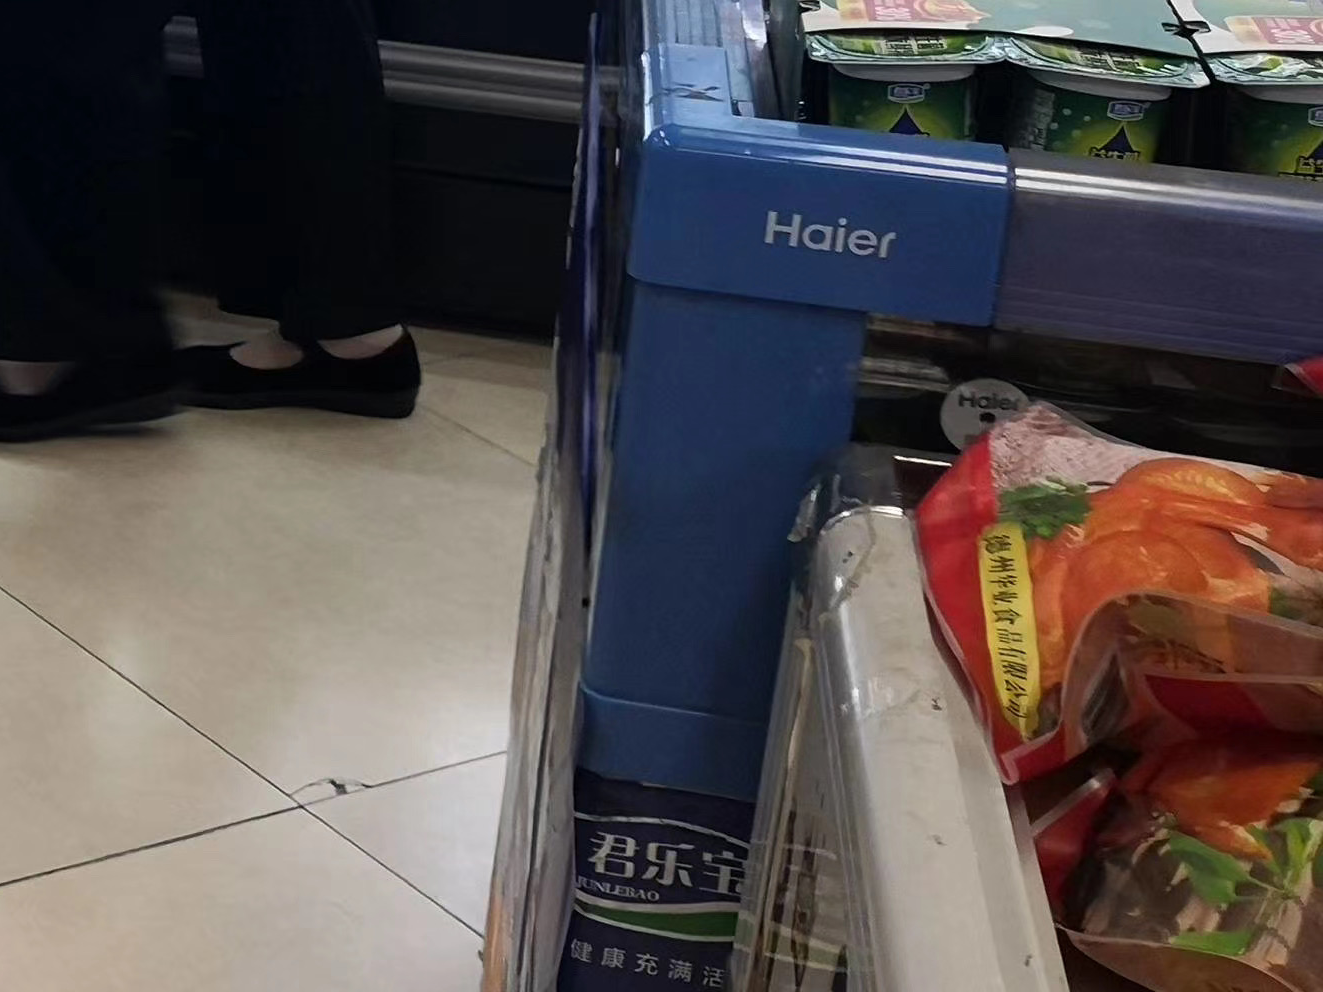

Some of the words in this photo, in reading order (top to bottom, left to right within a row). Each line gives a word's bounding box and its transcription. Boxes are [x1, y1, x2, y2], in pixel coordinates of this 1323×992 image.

[763, 209, 898, 260] Haier
[957, 387, 1021, 413] Haier
[589, 832, 748, 896] 君乐宝
